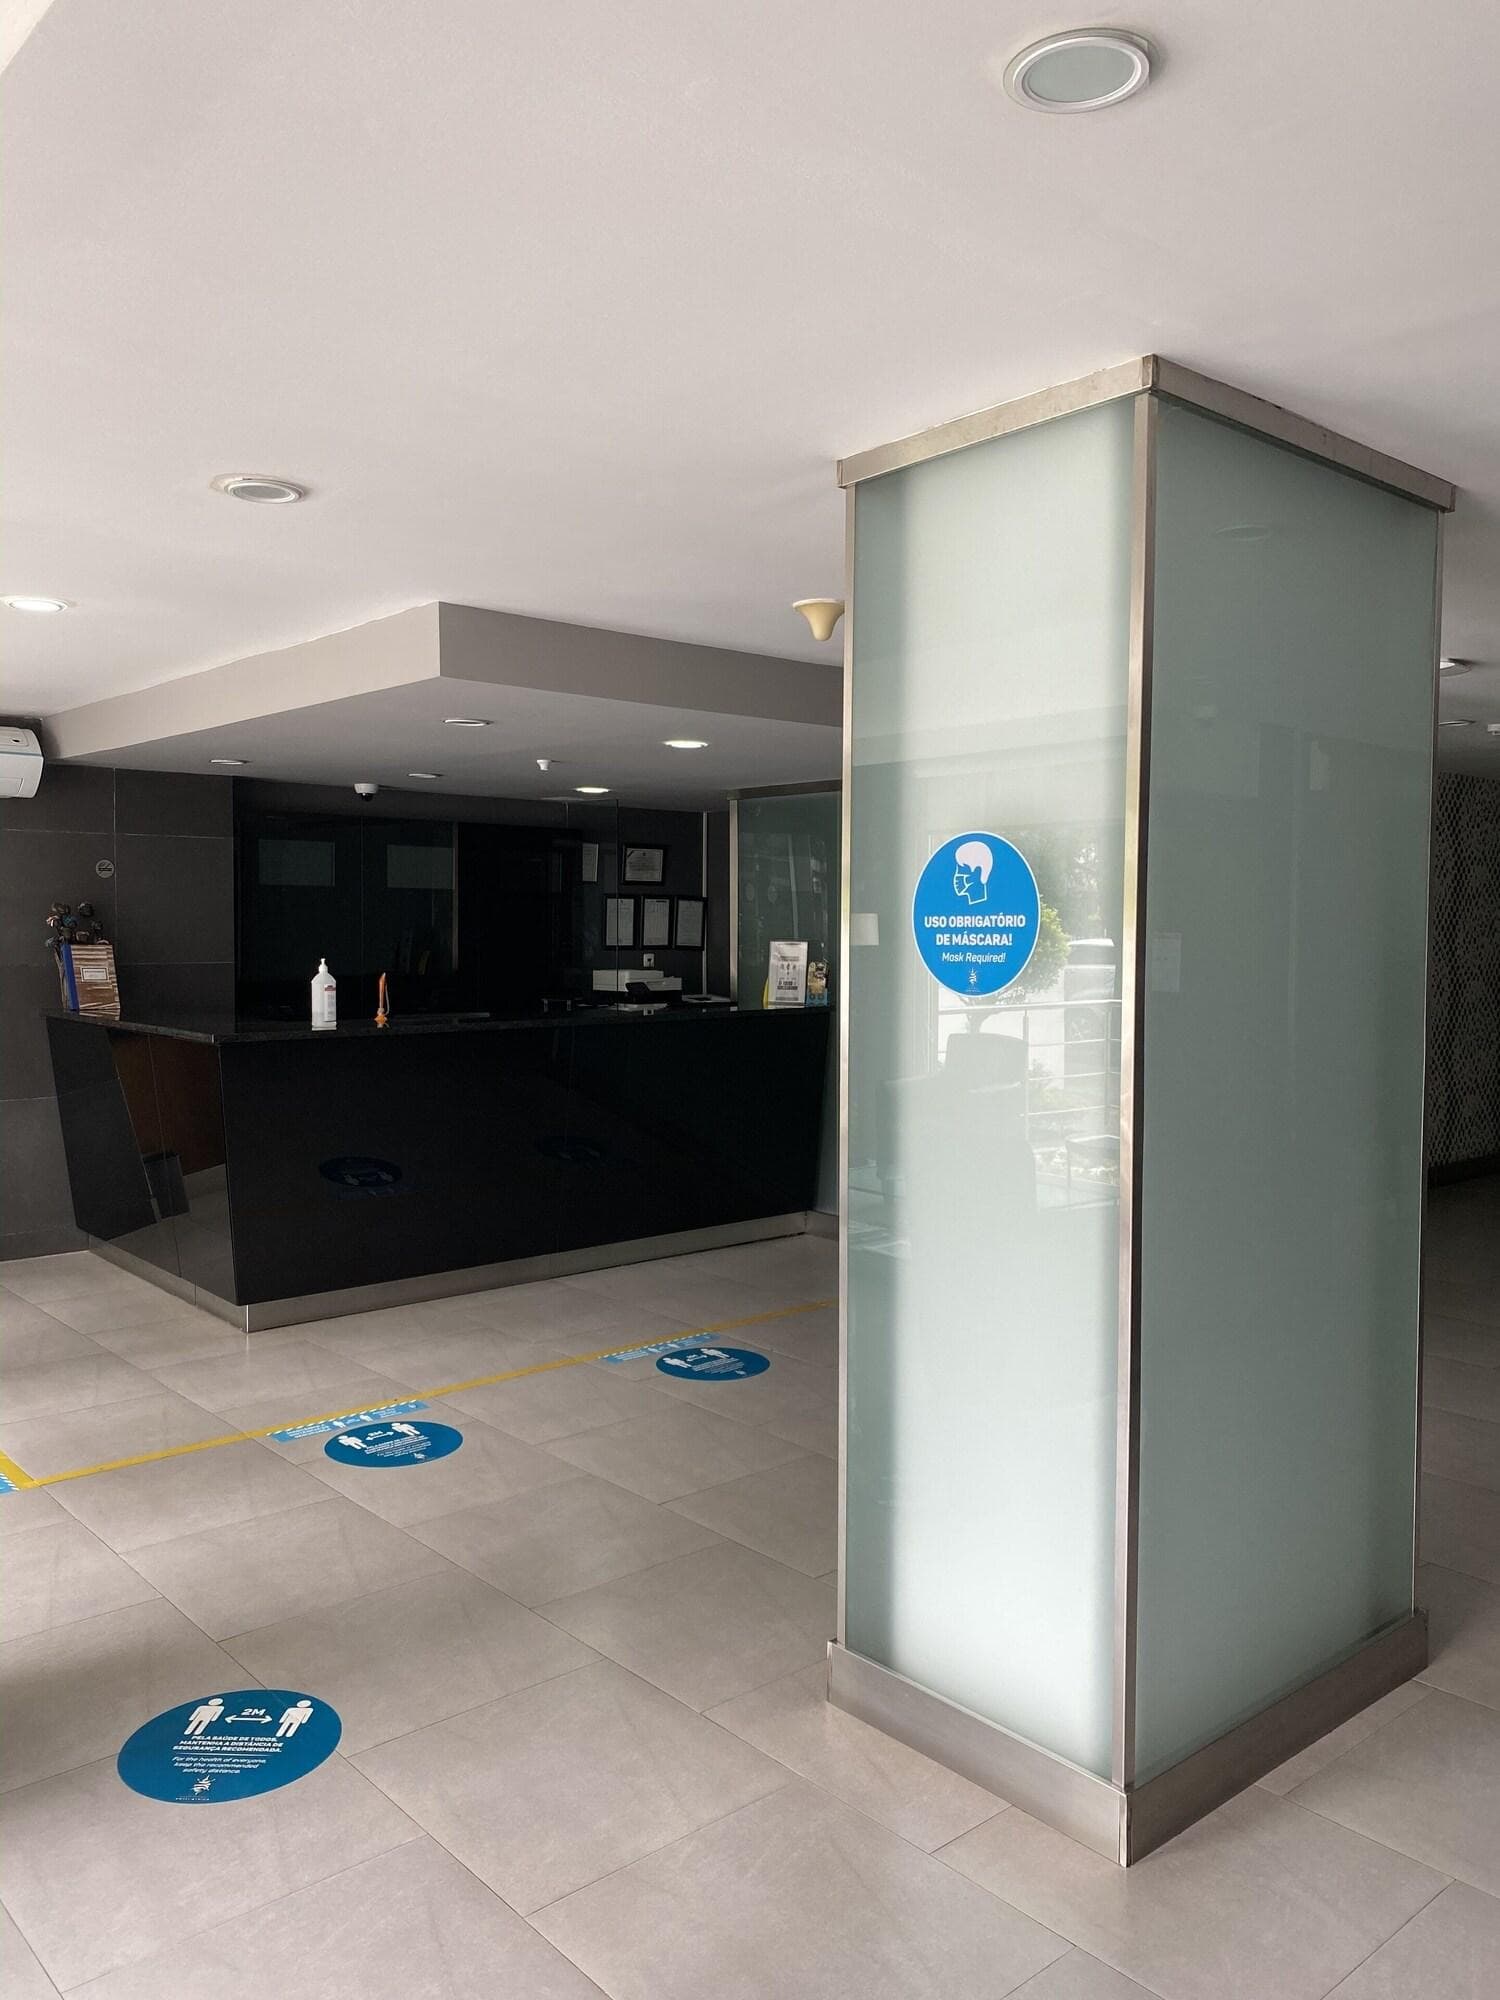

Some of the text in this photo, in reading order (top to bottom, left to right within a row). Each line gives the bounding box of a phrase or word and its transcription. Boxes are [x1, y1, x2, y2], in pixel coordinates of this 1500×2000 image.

[924, 912, 1026, 928] USO OBRIGATÓRIO
[935, 931, 1013, 946] DE MÁSCARA!
[942, 952, 1006, 965] Mask Required!
